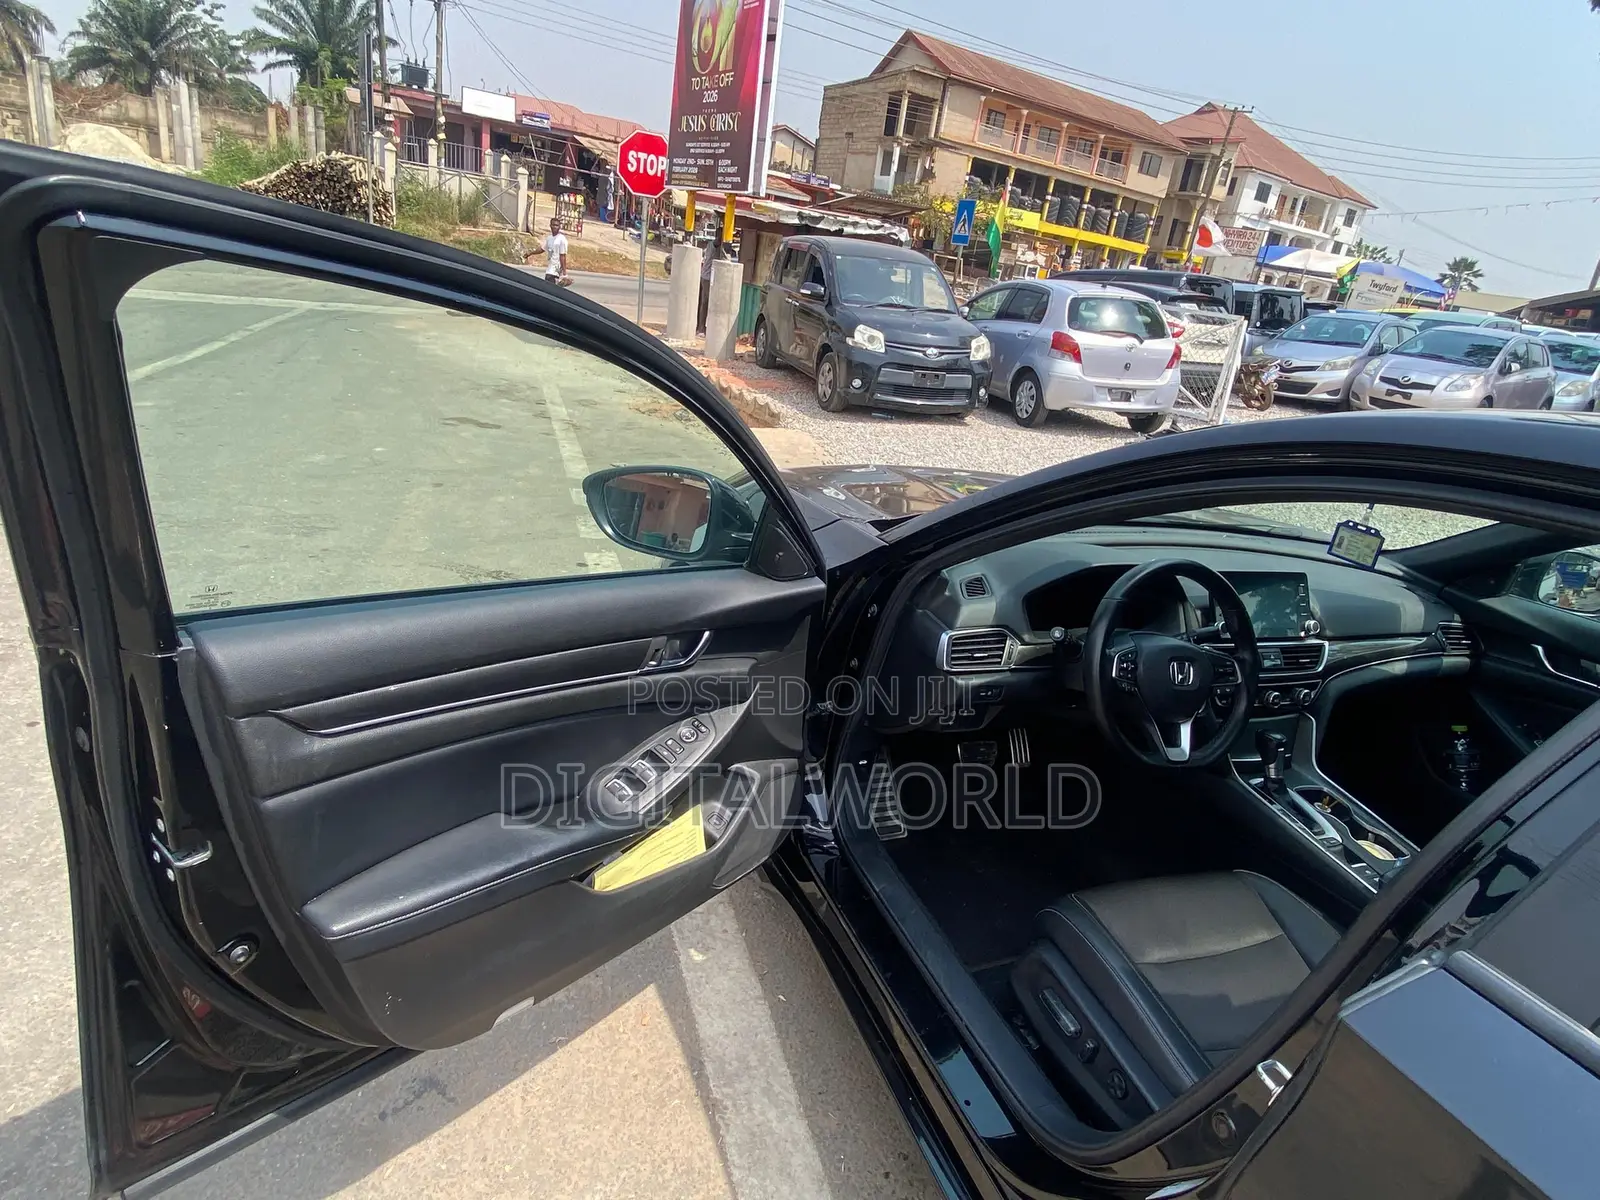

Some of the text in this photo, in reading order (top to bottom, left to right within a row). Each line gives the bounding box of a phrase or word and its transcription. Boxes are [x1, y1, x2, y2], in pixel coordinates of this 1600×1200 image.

[691, 72, 735, 91] TO TAKE OFF
[702, 89, 718, 103] 2026
[677, 114, 708, 132] JESUS
[627, 150, 667, 177] STOP
[1223, 239, 1257, 250] VENTURES
[1370, 280, 1398, 293] Twyford
